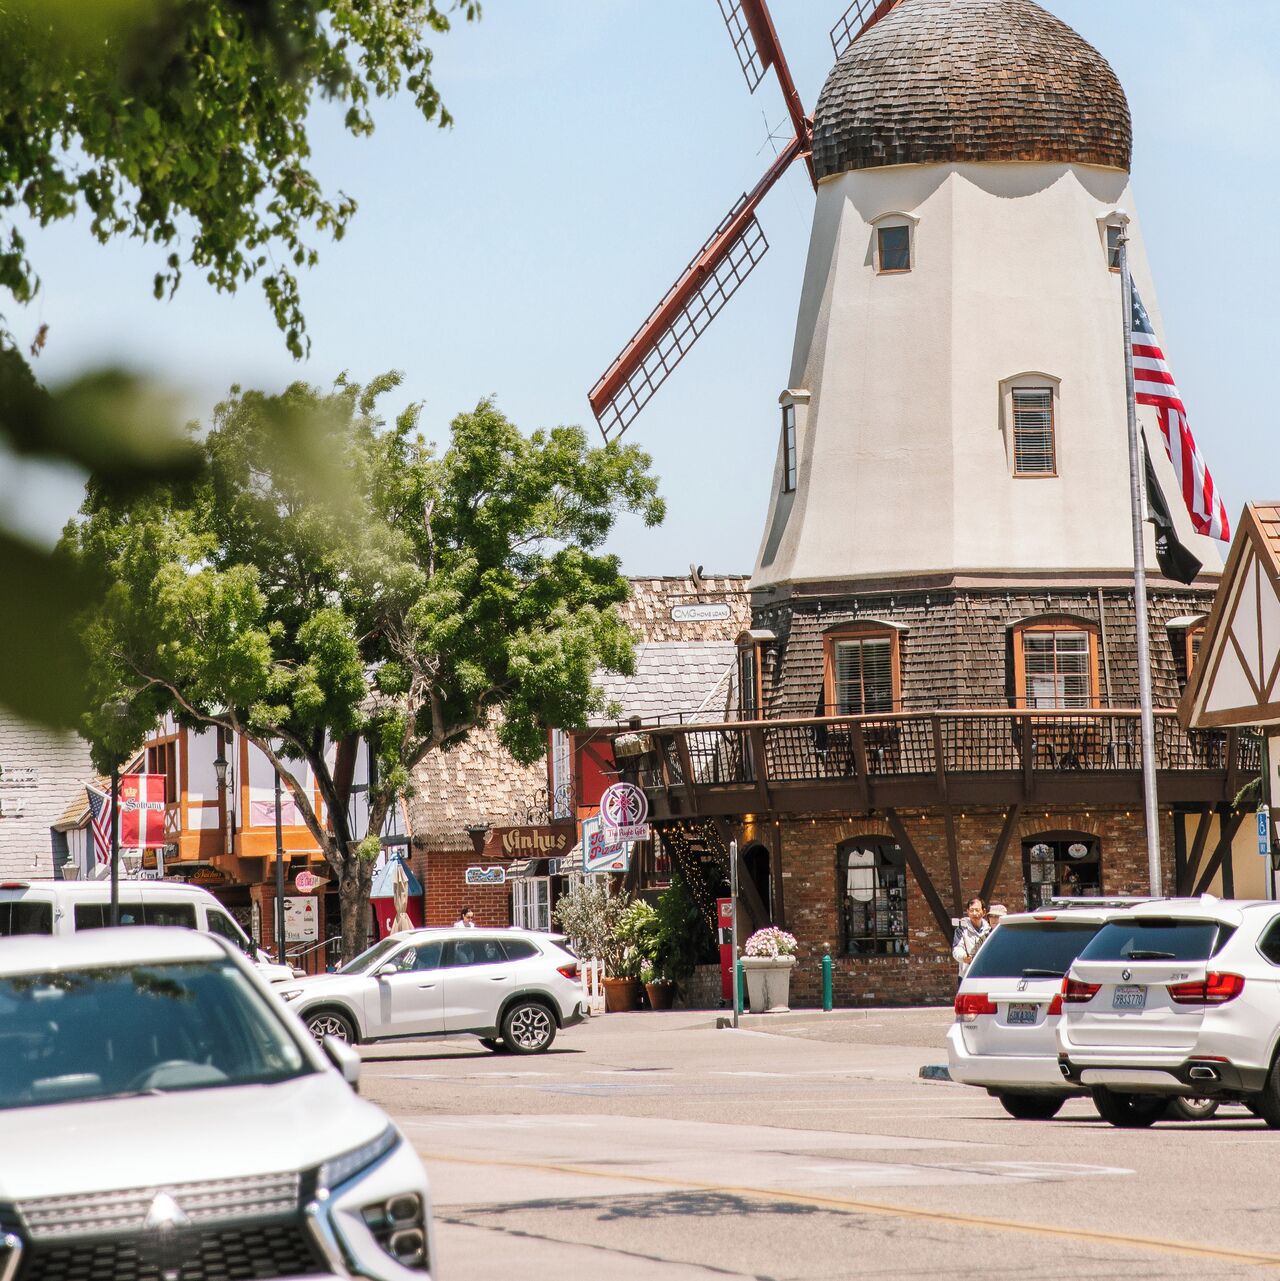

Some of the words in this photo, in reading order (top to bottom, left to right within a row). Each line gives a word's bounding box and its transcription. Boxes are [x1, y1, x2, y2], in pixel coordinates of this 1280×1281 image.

[674, 609, 697, 619] CMG
[124, 797, 162, 812] Solvang
[502, 828, 568, 853] Vinhus
